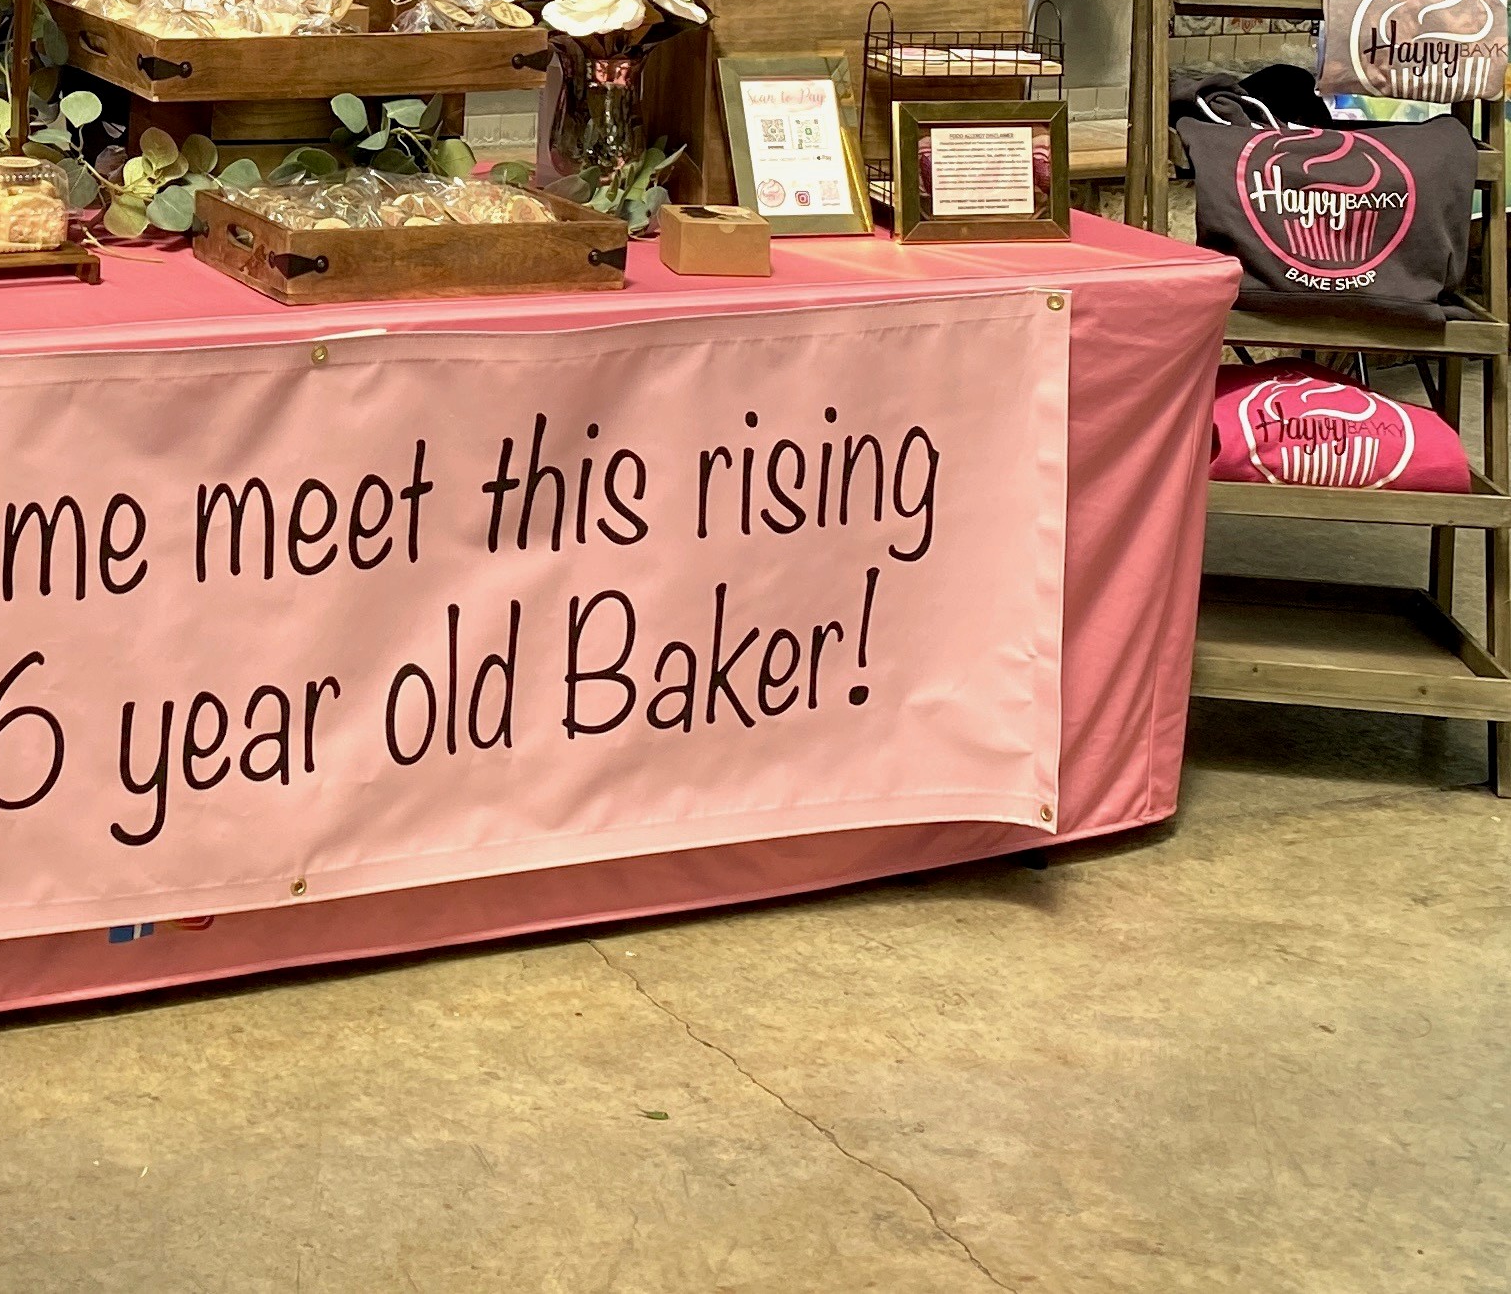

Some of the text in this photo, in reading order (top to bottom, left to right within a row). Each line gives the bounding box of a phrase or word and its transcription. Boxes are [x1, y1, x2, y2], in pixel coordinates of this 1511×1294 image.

[1346, 192, 1408, 209] BAYKY
[1285, 267, 1377, 291] BAKE SHOP
[195, 439, 435, 584] meet
[482, 412, 647, 554] this
[696, 406, 941, 563] rising
[110, 669, 342, 848] year
[385, 600, 521, 767] old
[564, 566, 881, 742] Baker!
